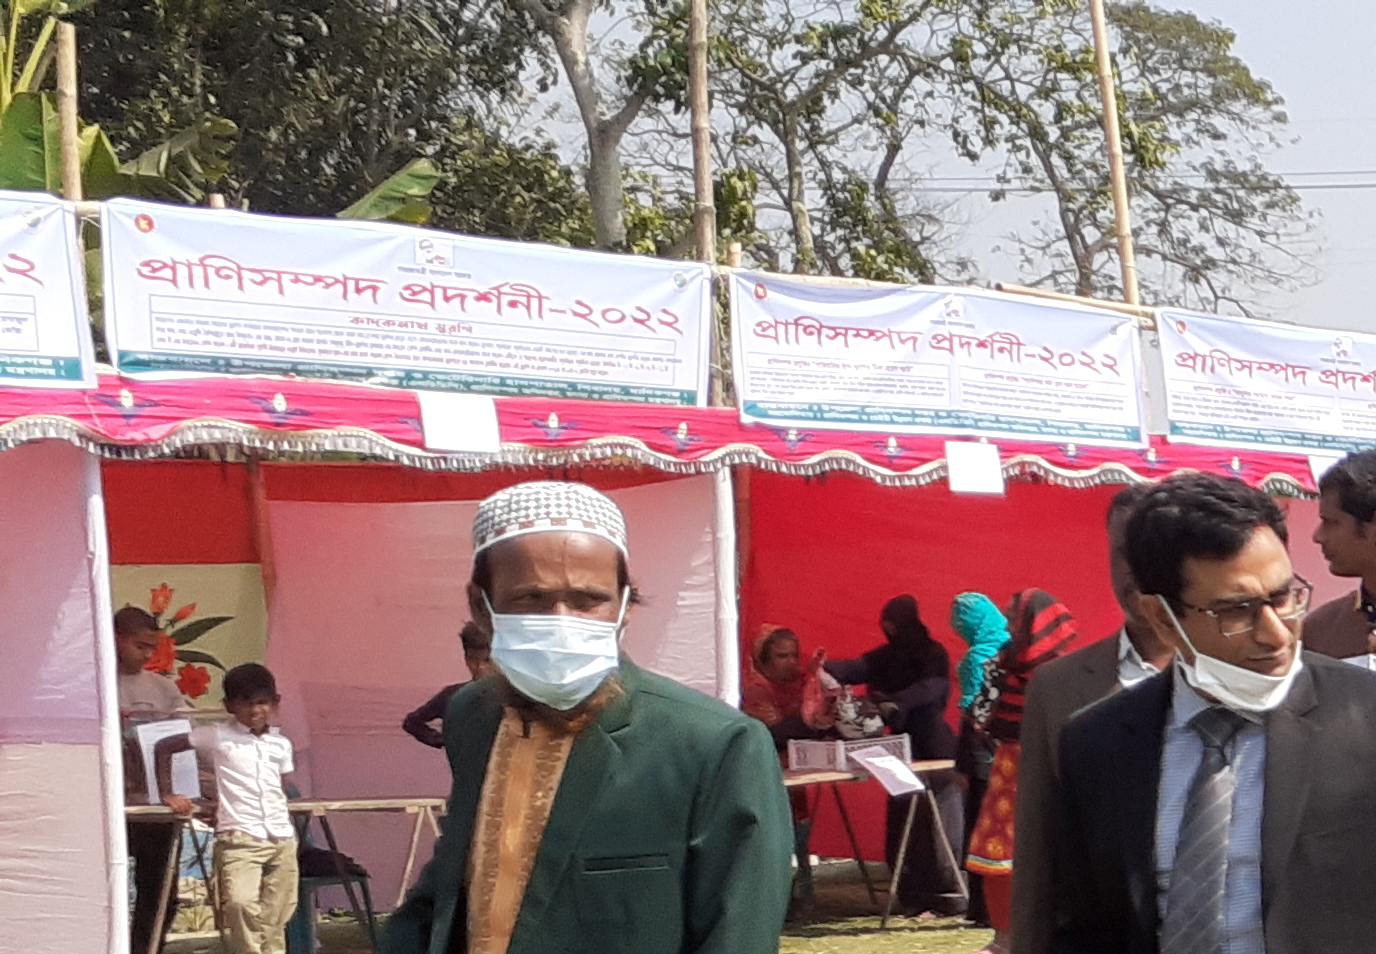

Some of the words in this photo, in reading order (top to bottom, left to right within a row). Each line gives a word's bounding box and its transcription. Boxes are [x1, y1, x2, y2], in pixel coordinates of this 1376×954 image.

[136, 254, 388, 304] প্রাণিসম্পদ
[398, 281, 684, 336] প্রদর্শনী-২০২২
[753, 316, 923, 352] প্রাণিসম্পদ
[928, 331, 1120, 376] প্রদর্শনী-২০২২
[1175, 349, 1312, 385] প্রাণিসম্পদ
